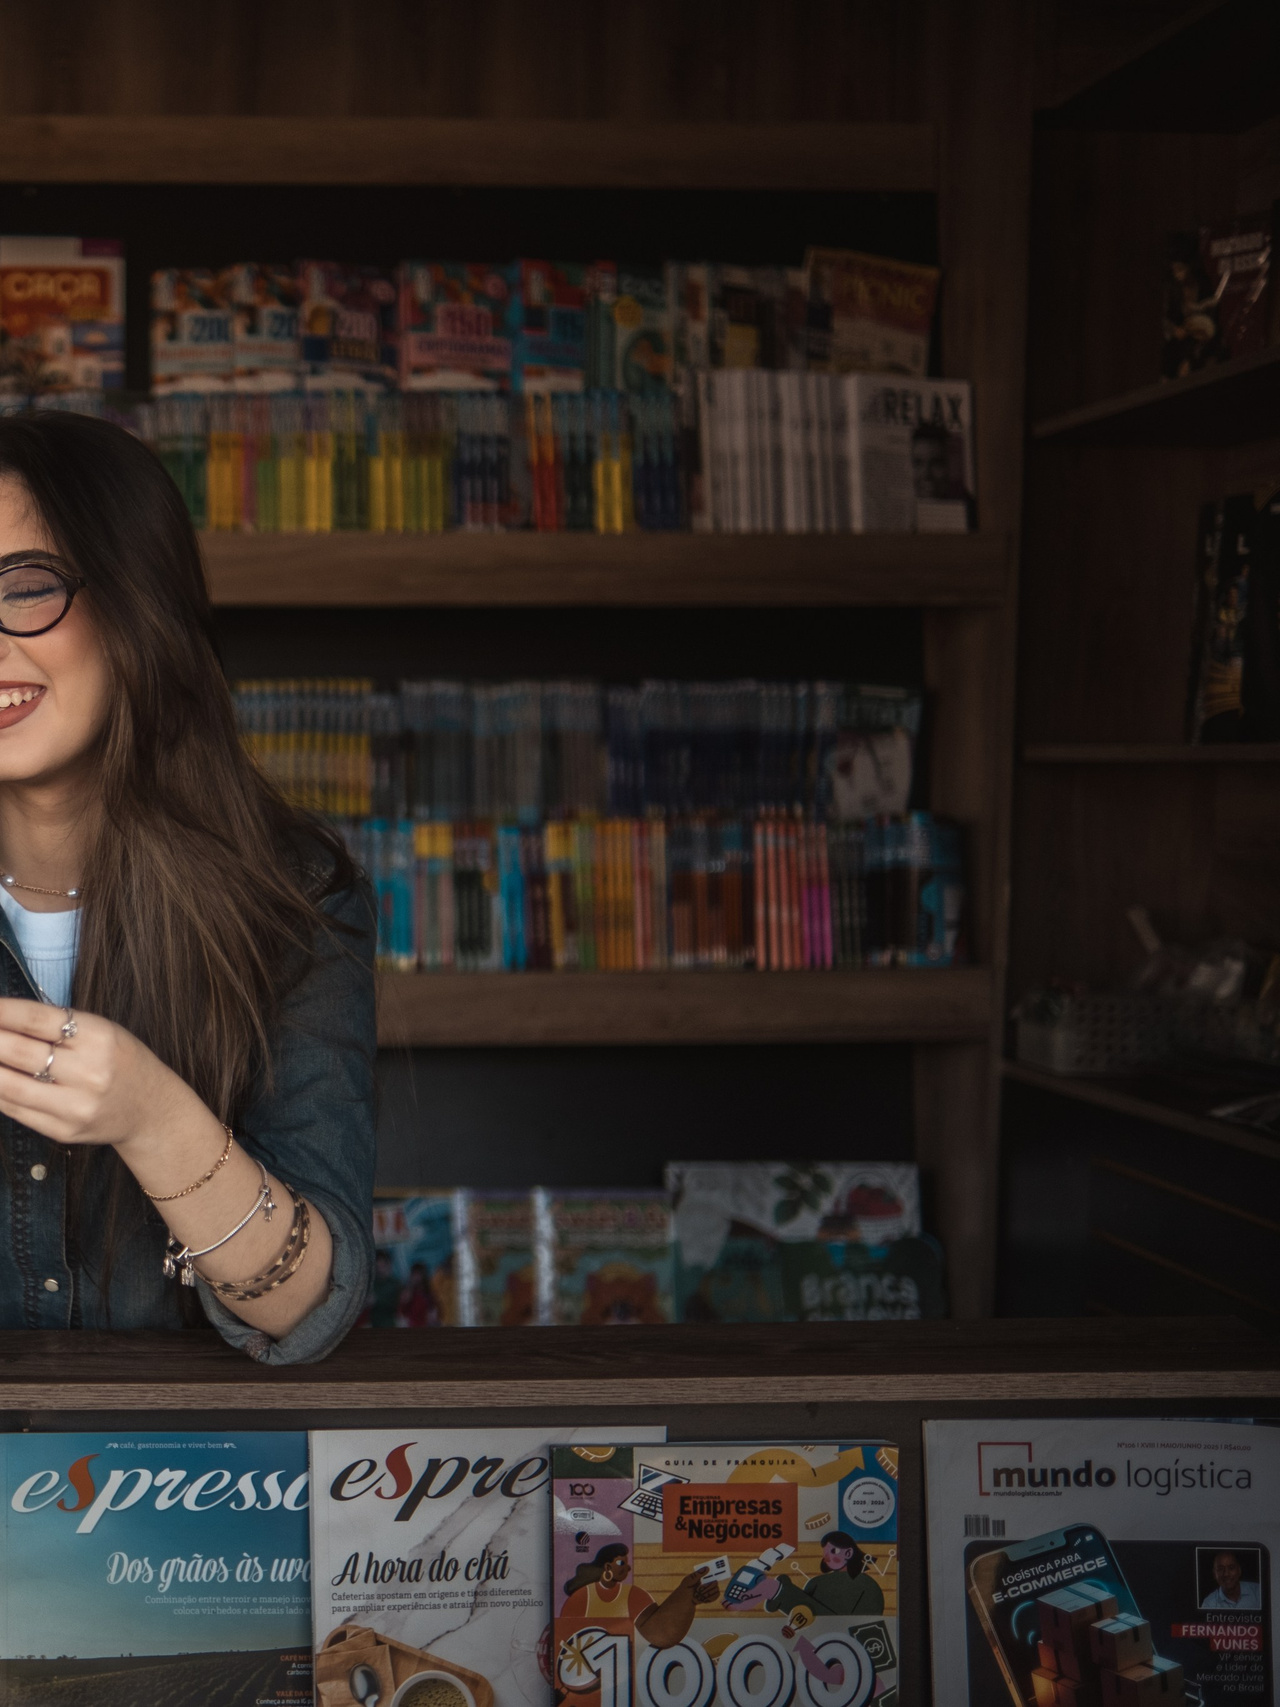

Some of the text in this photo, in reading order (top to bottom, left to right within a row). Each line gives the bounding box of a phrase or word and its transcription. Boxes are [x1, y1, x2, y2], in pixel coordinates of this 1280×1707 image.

[137, 1442, 181, 1450] gastronomia
[207, 1441, 223, 1449] bem
[726, 1458, 797, 1466] FRANQUIAS
[992, 1457, 1252, 1496] mundo logística
[569, 1483, 595, 1496] 100
[680, 1496, 782, 1518] Empresas
[675, 1516, 782, 1544] & Negócios
[106, 1551, 158, 1584] Dos
[158, 1553, 233, 1593] grãos
[235, 1552, 268, 1583] às
[331, 1549, 510, 1586] A hora do chá
[1001, 1552, 1082, 1586] LOGÍSTICA PARA
[991, 1556, 1108, 1603] E-COMMERCE
[145, 1595, 291, 1606] Combinação entre terroir manejo
[331, 1592, 375, 1601] Cafeterias
[376, 1591, 412, 1602] apostam
[428, 1590, 459, 1600] origens
[467, 1589, 488, 1599] tipos
[489, 1587, 532, 1597] diferentes
[173, 1605, 304, 1615] coloca vinhedos cafezais lado
[331, 1605, 351, 1614] para
[353, 1603, 385, 1614] ampliar
[387, 1601, 438, 1613] experiências
[449, 1601, 473, 1610] atrair
[490, 1600, 511, 1608] novo
[512, 1598, 544, 1609] público
[1206, 1612, 1262, 1623] Entrevista
[1182, 1625, 1259, 1637] FERNANDO
[1213, 1639, 1259, 1650] YUNES
[1219, 1652, 1263, 1661] VP sênior
[581, 1632, 877, 1707] 1000
[1250, 1663, 1263, 1671] do
[1196, 1673, 1264, 1681] Mercado Livre
[1239, 1684, 1264, 1692] Brasil
